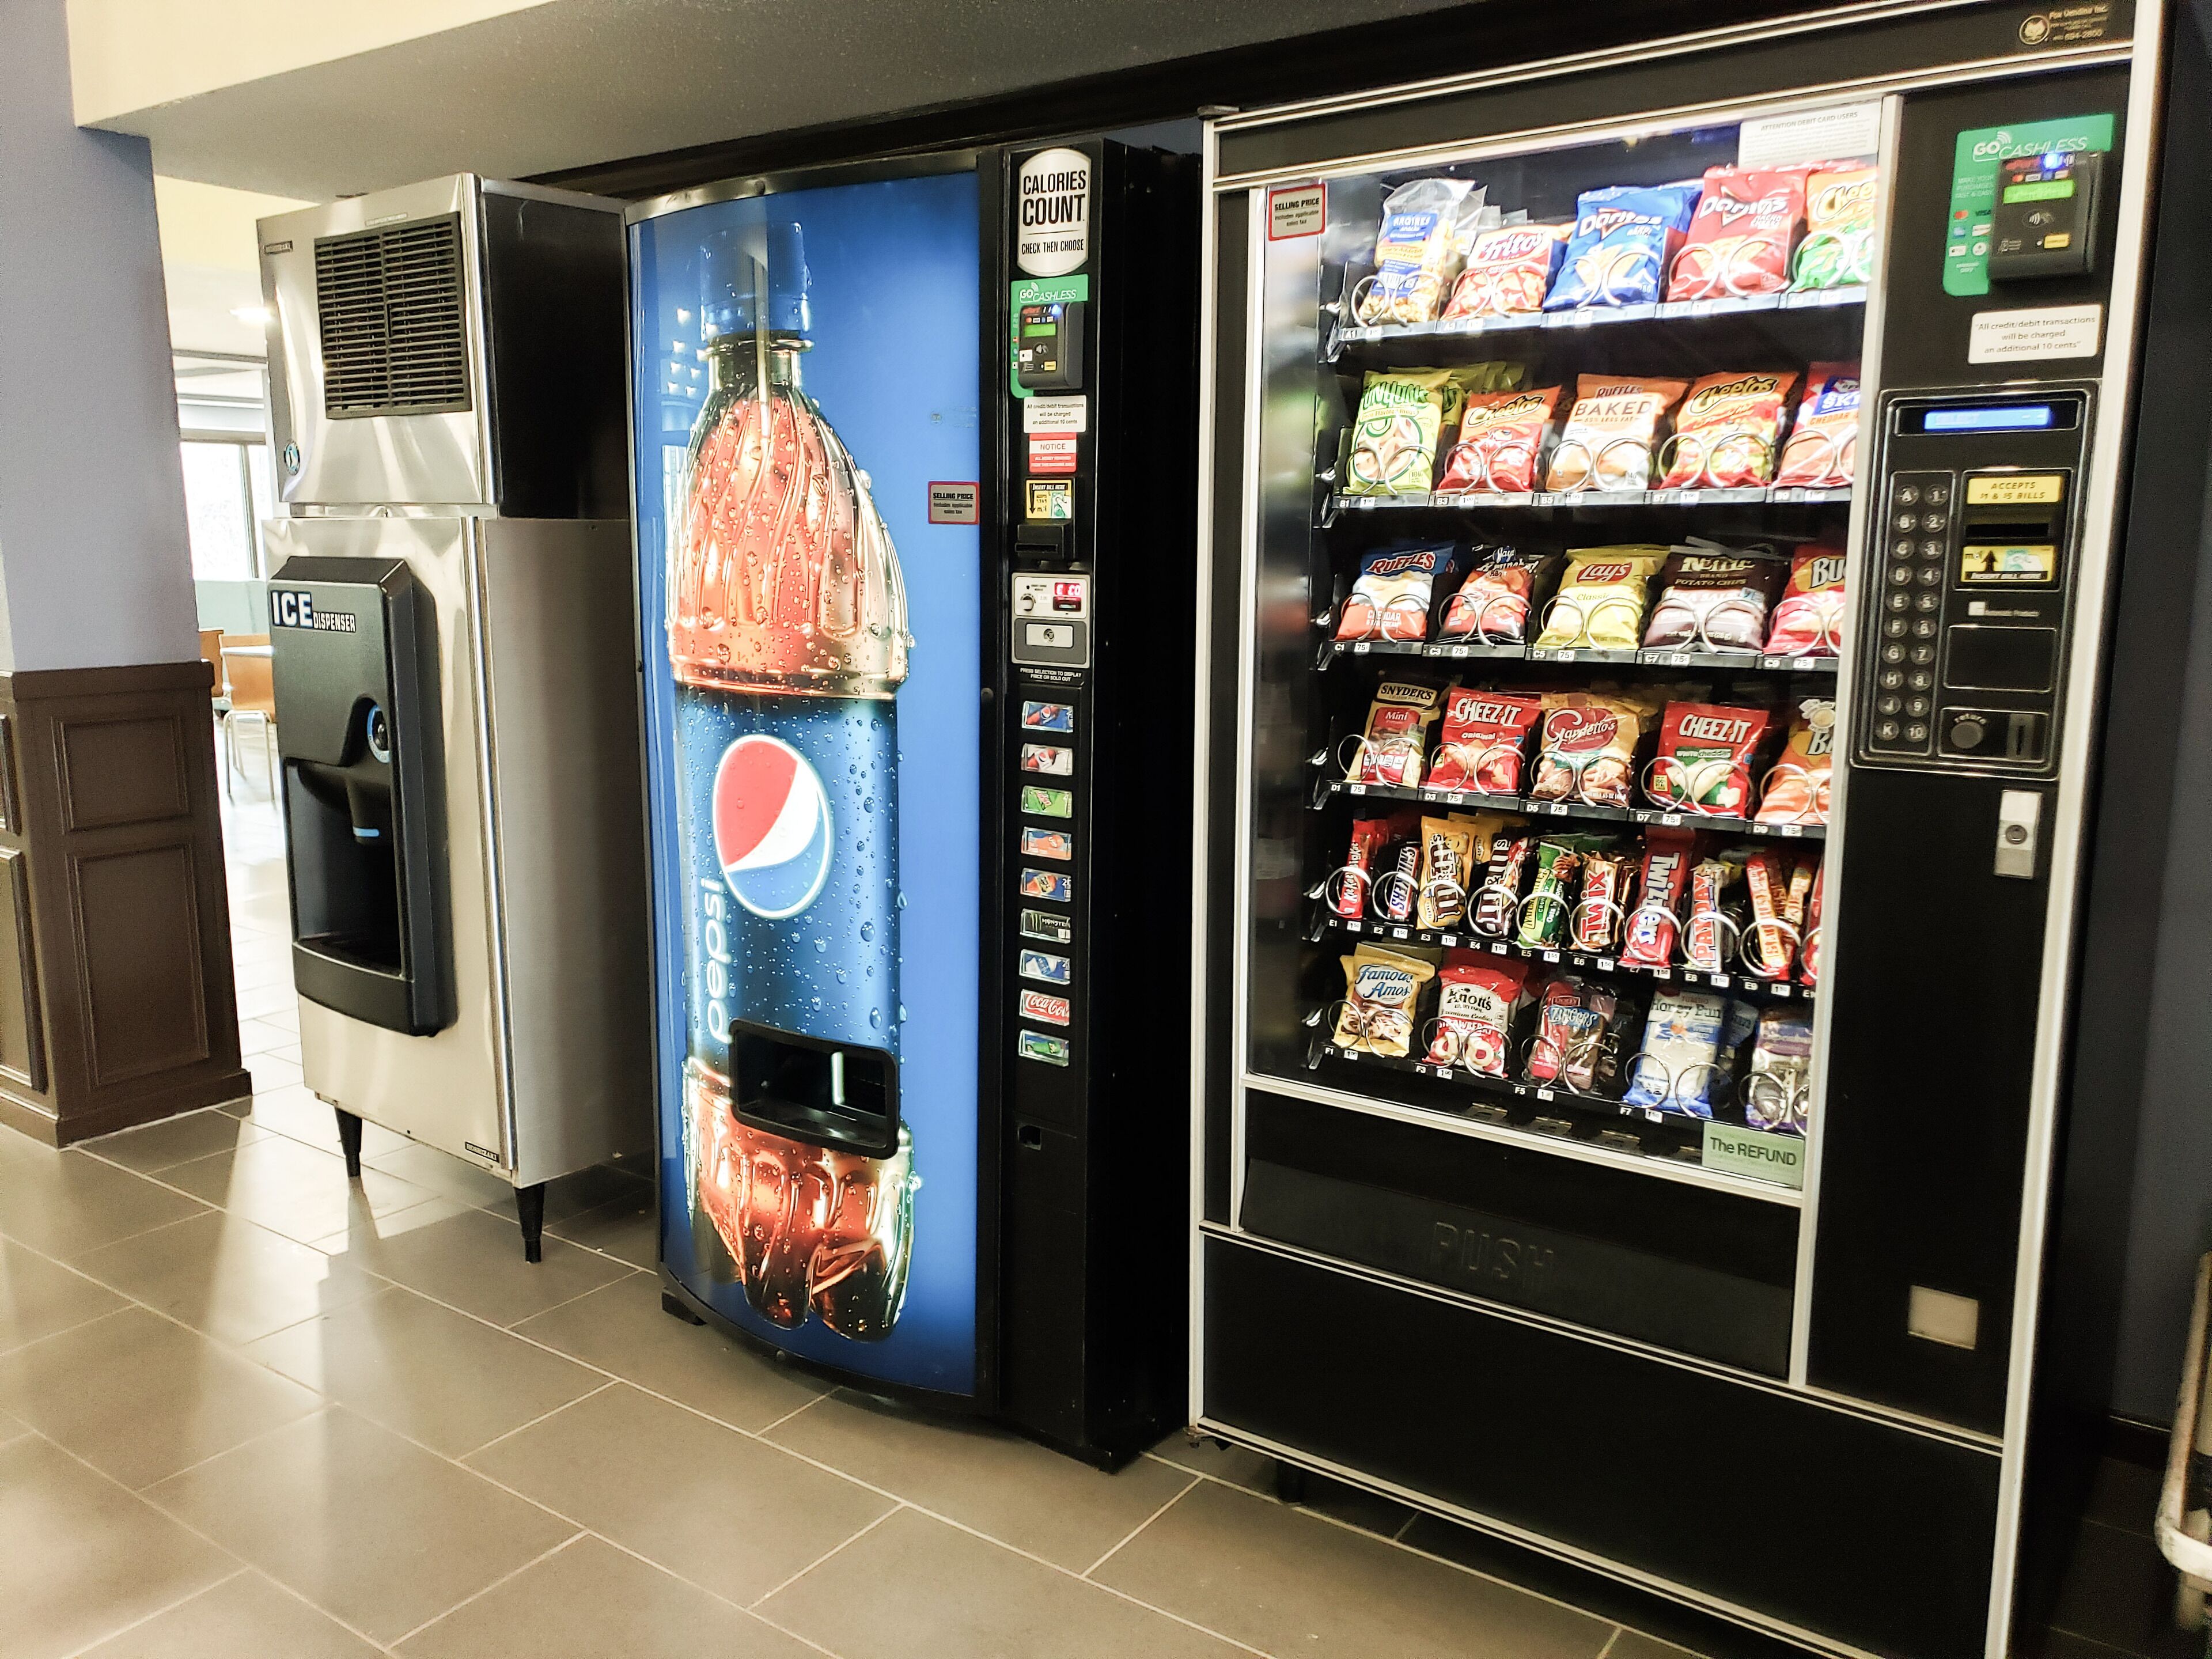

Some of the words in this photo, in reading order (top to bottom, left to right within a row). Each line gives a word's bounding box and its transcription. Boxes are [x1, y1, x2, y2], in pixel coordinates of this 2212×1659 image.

[1761, 122, 1796, 131] ATTENTION
[1797, 118, 1816, 126] DEBIT
[1817, 115, 1835, 123] CARD
[1836, 112, 1858, 120] USERS
[1999, 137, 2088, 158] CASHLESS
[1023, 170, 1086, 195] CALORIES
[1275, 200, 1300, 211] SELLING
[1301, 198, 1319, 207] PRICE
[1699, 196, 1788, 219] Doritos
[1578, 211, 1663, 237] Doritos
[1022, 243, 1040, 255] CHECK
[1043, 241, 1058, 252] THEN
[1060, 239, 1084, 252] CHOOSE
[1020, 289, 1033, 299] GO
[1033, 290, 1077, 301] CASHLESS
[2043, 317, 2095, 326] transactions
[2030, 330, 2065, 340] charged
[1996, 344, 2039, 353] additional
[1687, 376, 1778, 416] Cheetos
[1468, 395, 1544, 426] Cheetos
[1575, 401, 1652, 416] BAKED
[1040, 442, 1066, 450] NOTICE
[1991, 482, 2036, 490] ACCEPTS
[1437, 497, 1448, 506] B3
[1903, 488, 1912, 502] A
[1933, 488, 1941, 502] 1
[2016, 491, 2044, 499] BILLS
[1340, 499, 1349, 507] B1
[1929, 516, 1939, 528] 2
[1898, 544, 1907, 554] C
[1367, 552, 1434, 574] RUFFLES
[1810, 557, 1846, 588] BU
[1896, 569, 1904, 581] D
[1675, 578, 1714, 586] POTATO
[1893, 597, 1902, 608] E
[1923, 597, 1933, 608] 5
[272, 592, 313, 627] ICE
[313, 612, 355, 632] DISPENSER
[1892, 622, 1900, 632] F
[1430, 647, 1441, 656] C3
[1645, 654, 1658, 662] C7
[1887, 673, 1896, 685] H
[1381, 684, 1433, 700] SNYDER'S
[1386, 711, 1408, 721] Mini
[1544, 709, 1616, 751] Gardetto's
[1883, 725, 1892, 735] K
[1390, 847, 1416, 911] SNIKERS
[1637, 852, 1680, 945] Twizzers
[1694, 874, 1715, 961] PAYDAY
[1470, 941, 1480, 949] E4
[700, 877, 732, 1044] pepsi
[1355, 965, 1413, 984] Famous
[1363, 982, 1411, 999] Amos
[1710, 1137, 1734, 1153] The
[1737, 1143, 1797, 1166] REFUND
